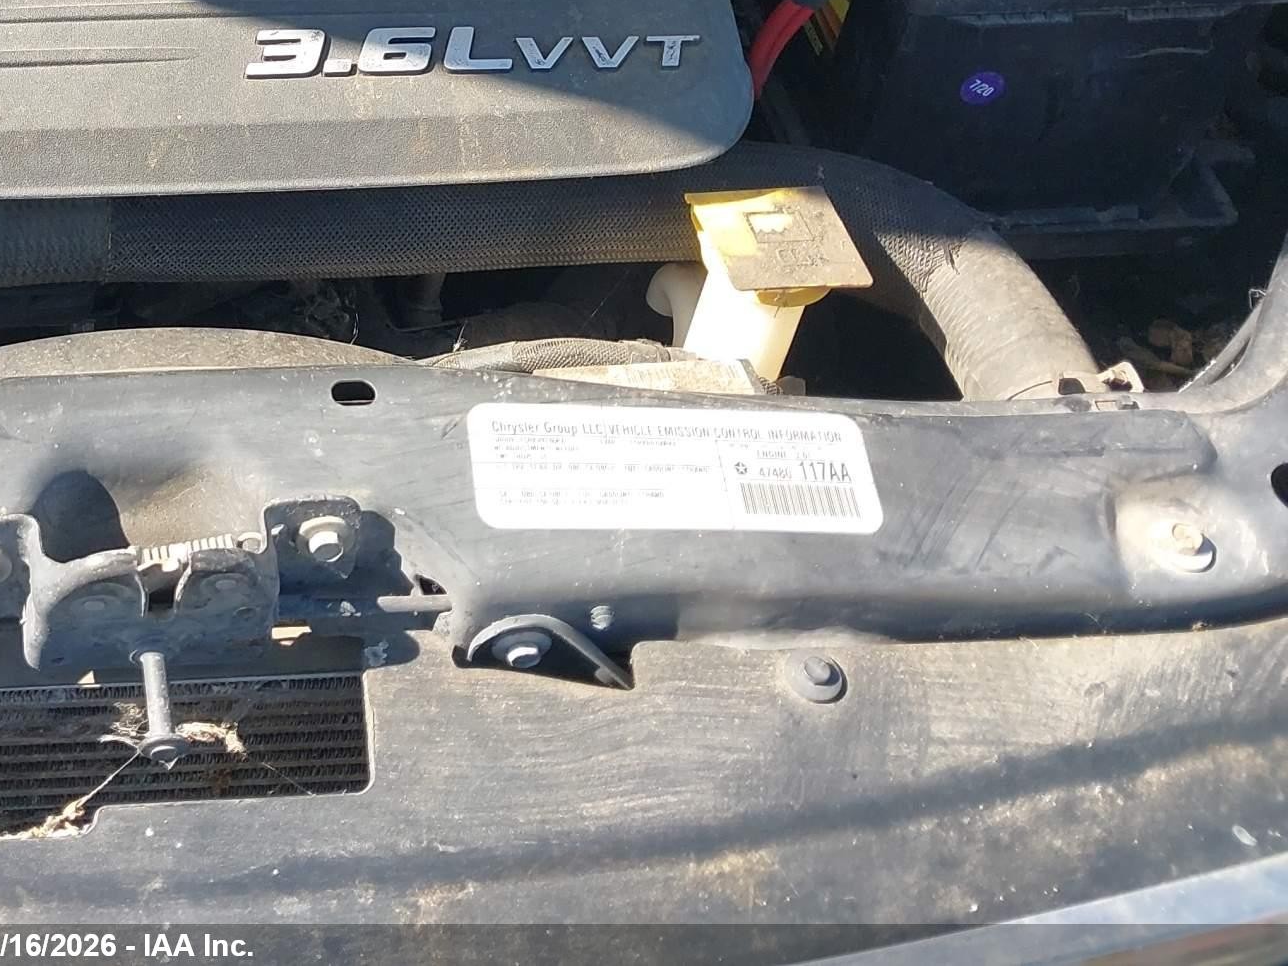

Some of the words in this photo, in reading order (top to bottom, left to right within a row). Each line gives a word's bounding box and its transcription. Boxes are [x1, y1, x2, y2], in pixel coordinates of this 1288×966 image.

[244, 26, 513, 79] 3.6L
[516, 34, 700, 70] VVT
[491, 421, 539, 435] Chrysler
[544, 422, 577, 436] Group
[582, 423, 603, 435] LLC
[608, 425, 653, 436] VEHICLE
[658, 425, 710, 438] EMISSION
[714, 427, 761, 440] CONTROL
[767, 429, 843, 443] INFORMATION
[799, 461, 852, 482] 117AA
